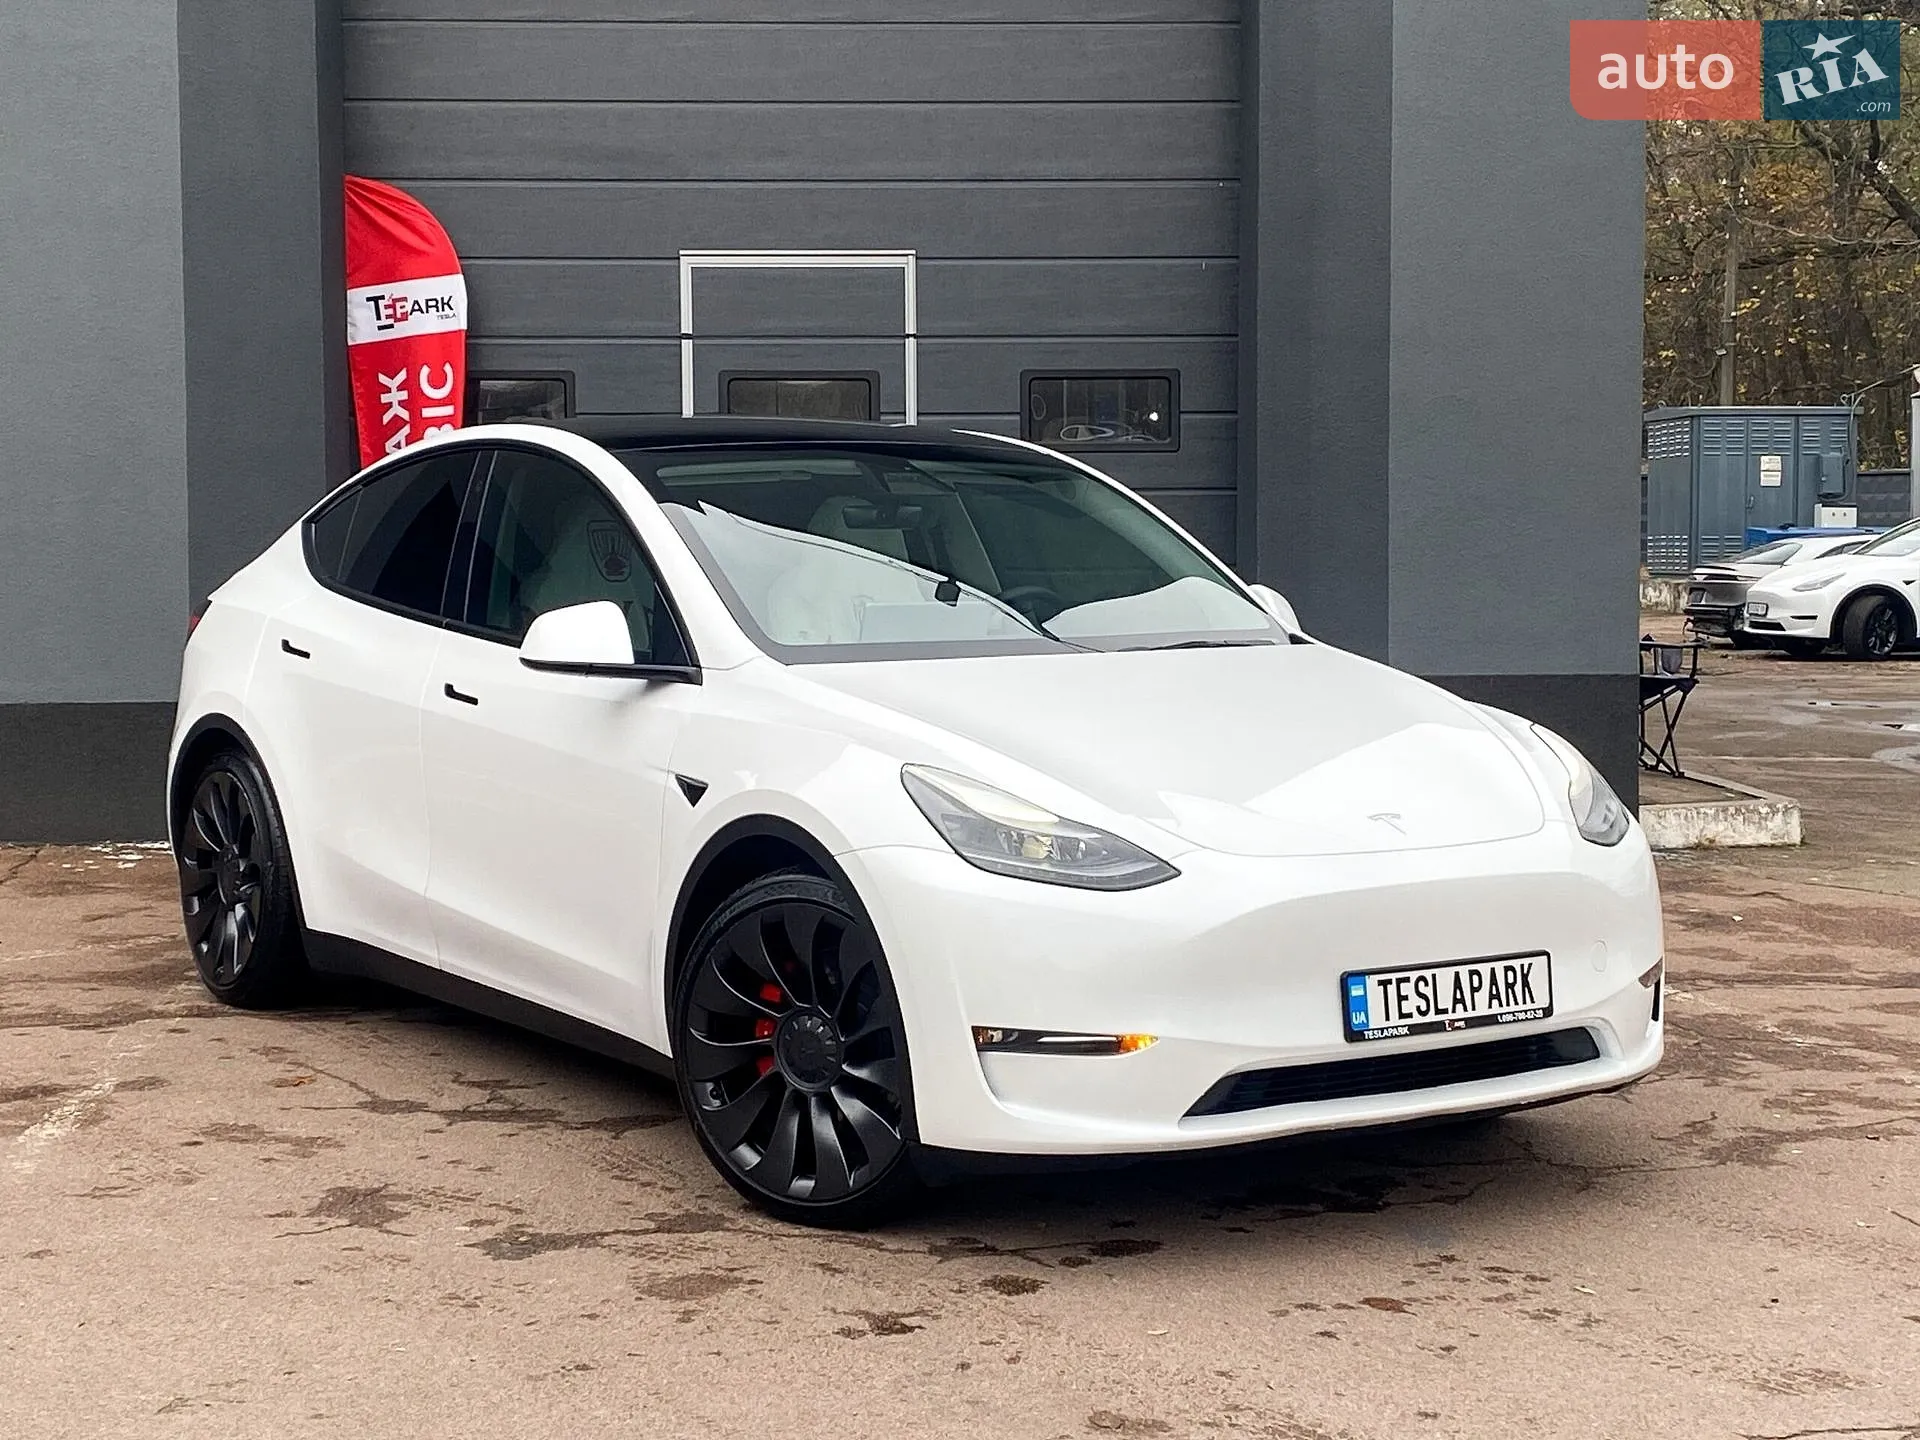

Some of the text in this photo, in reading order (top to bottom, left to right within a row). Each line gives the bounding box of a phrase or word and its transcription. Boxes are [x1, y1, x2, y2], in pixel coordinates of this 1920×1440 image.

[1377, 962, 1536, 1022] TESLAPARK
[1352, 1011, 1367, 1024] UA
[1363, 1026, 1410, 1039] TESLAPARK
